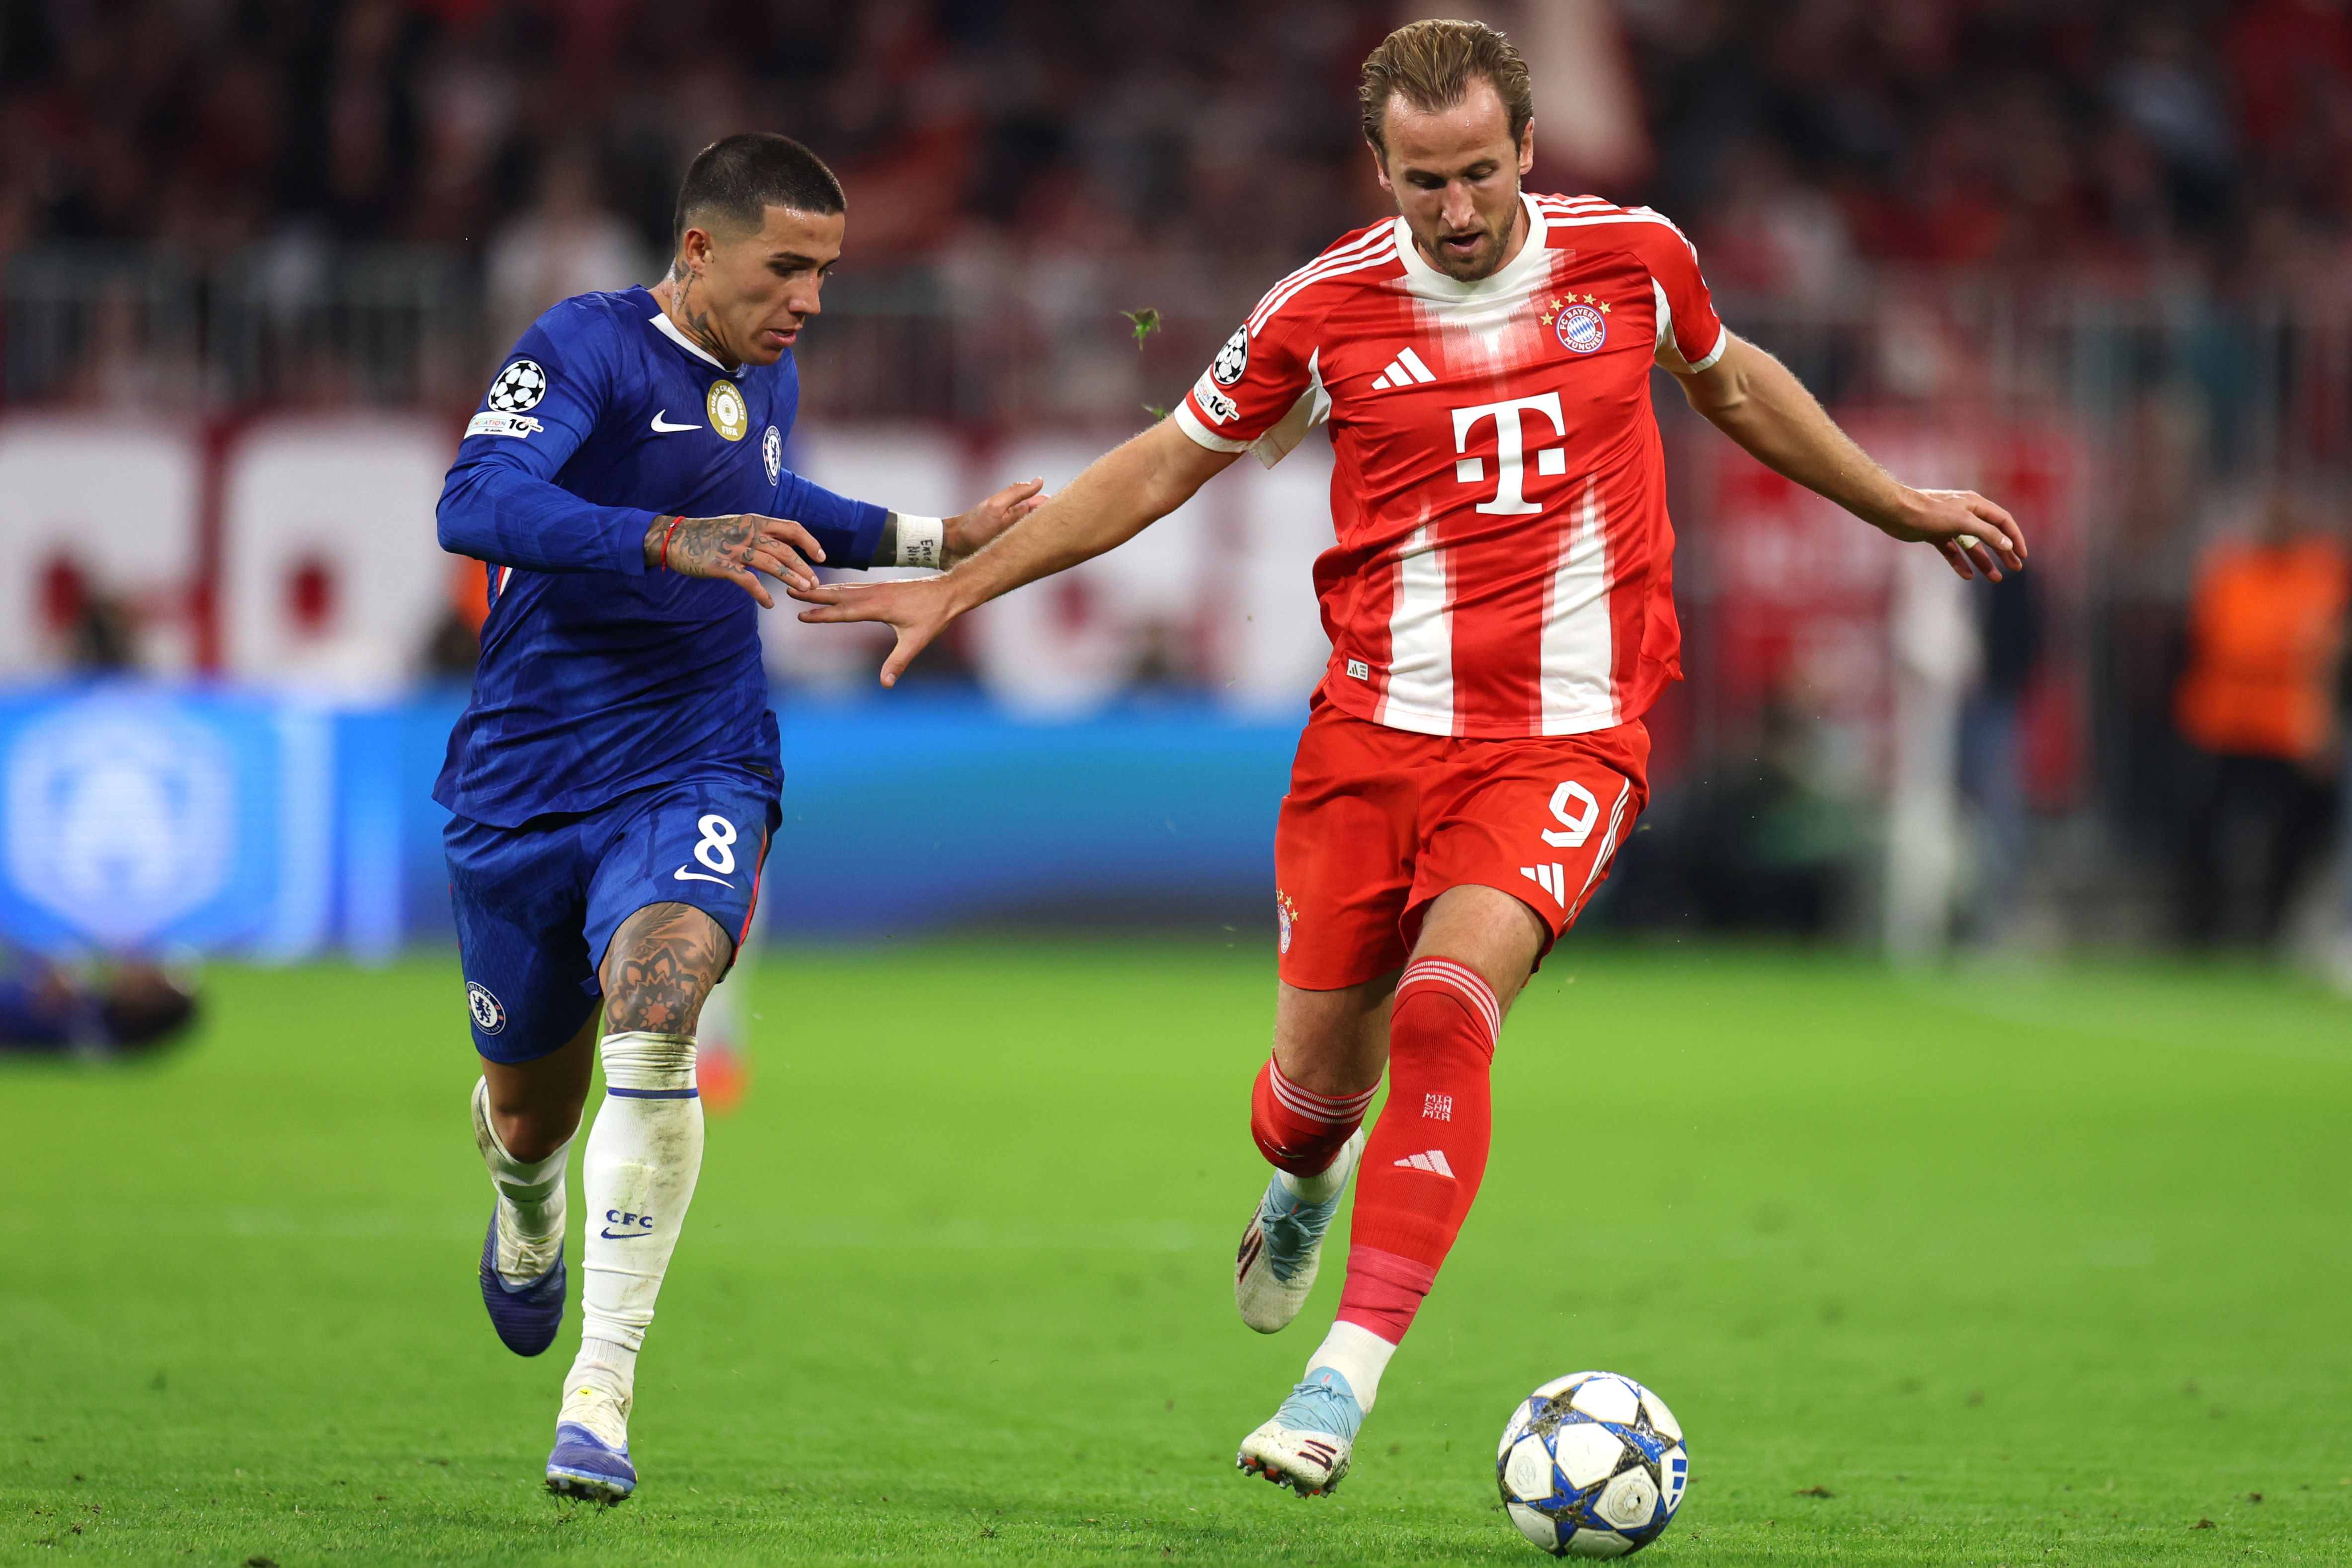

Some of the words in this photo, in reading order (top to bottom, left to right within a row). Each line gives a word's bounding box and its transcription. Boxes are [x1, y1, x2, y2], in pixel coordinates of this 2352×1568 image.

[1560, 318, 1568, 330] FC
[1566, 308, 1600, 324] BAYERN
[711, 388, 720, 414] WORLD
[720, 385, 744, 421] CHAMPIONS
[1210, 395, 1226, 416] 10
[509, 418, 529, 431] 10
[721, 425, 738, 437] FIFA
[1451, 392, 1566, 515] T
[1541, 780, 1601, 848] 9
[694, 814, 737, 874] 8
[468, 984, 490, 1000] CHELSEA
[1424, 1101, 1452, 1114] SAN
[1425, 1093, 1452, 1105] MIA
[1422, 1109, 1451, 1122] MIA
[606, 1209, 653, 1229] CFC
